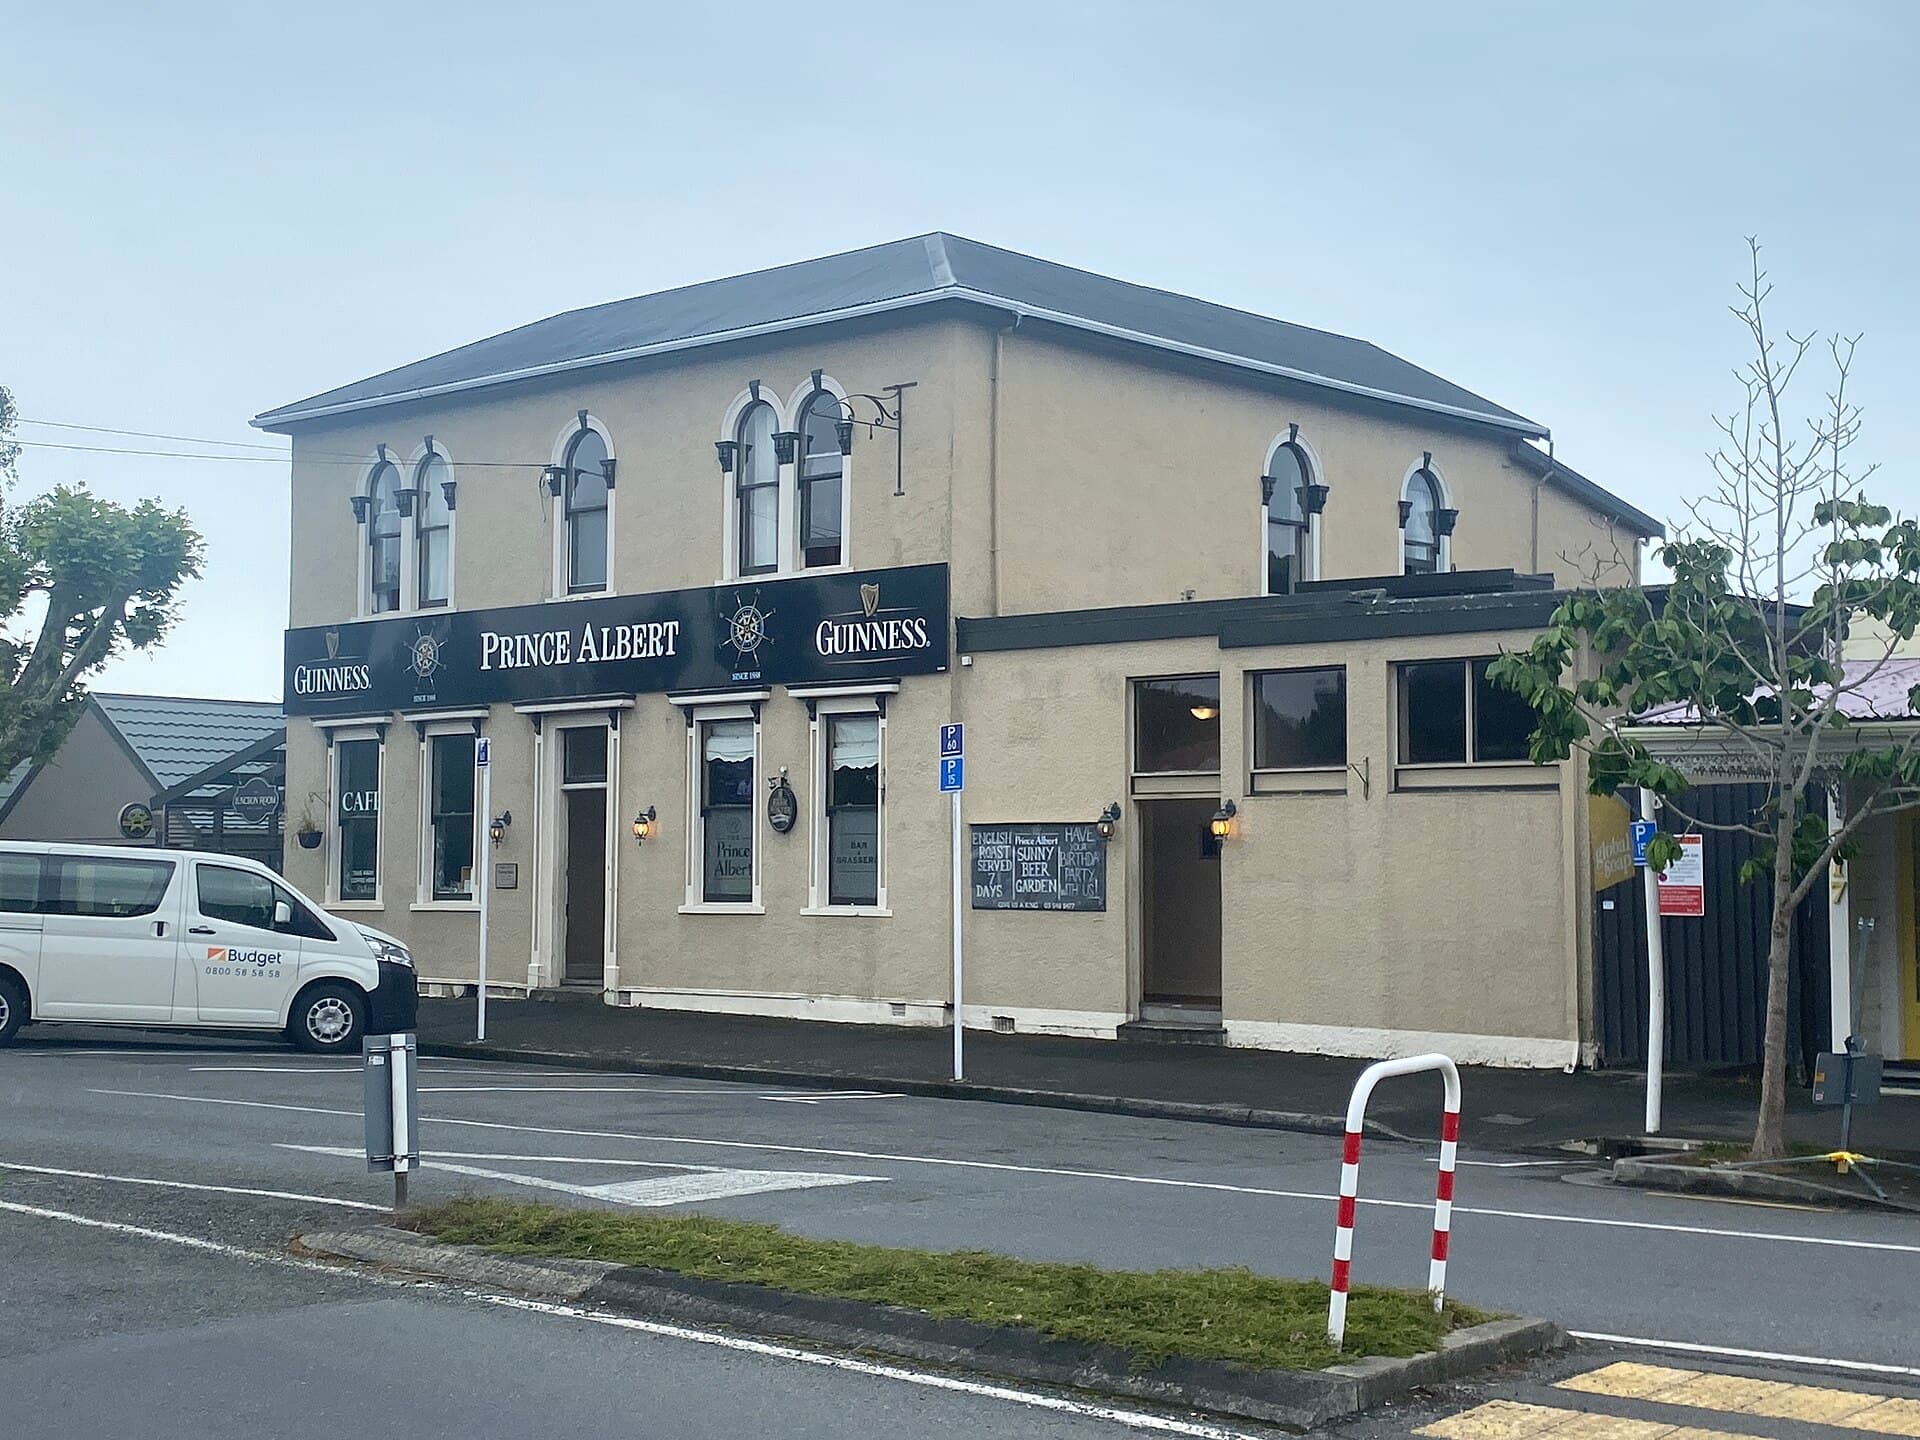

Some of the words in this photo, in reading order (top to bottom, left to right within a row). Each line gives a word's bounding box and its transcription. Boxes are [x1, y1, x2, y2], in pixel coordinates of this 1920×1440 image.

[816, 618, 928, 656] GUINNESS
[480, 631, 571, 671] PRINCE
[576, 621, 680, 664] ALBERT
[294, 665, 371, 695] GUINNESS
[947, 726, 956, 739] P
[947, 739, 957, 751] 60
[947, 760, 956, 774] P
[947, 774, 956, 785] 15
[972, 831, 1012, 845] ENGLISH
[1065, 827, 1096, 842] HAVE
[1635, 825, 1647, 842] P
[717, 841, 750, 858] Prince
[979, 845, 1012, 859] ROAST
[1017, 846, 1054, 861] SUNNY
[977, 859, 1012, 872] SERVED
[1021, 862, 1050, 877] BEER
[1064, 867, 1096, 883] PARTY
[976, 885, 1003, 898] DAYS
[1016, 879, 1057, 893] GARDEN
[228, 948, 282, 967] Budget
[205, 966, 231, 975] 0800
[268, 969, 281, 978] 58
